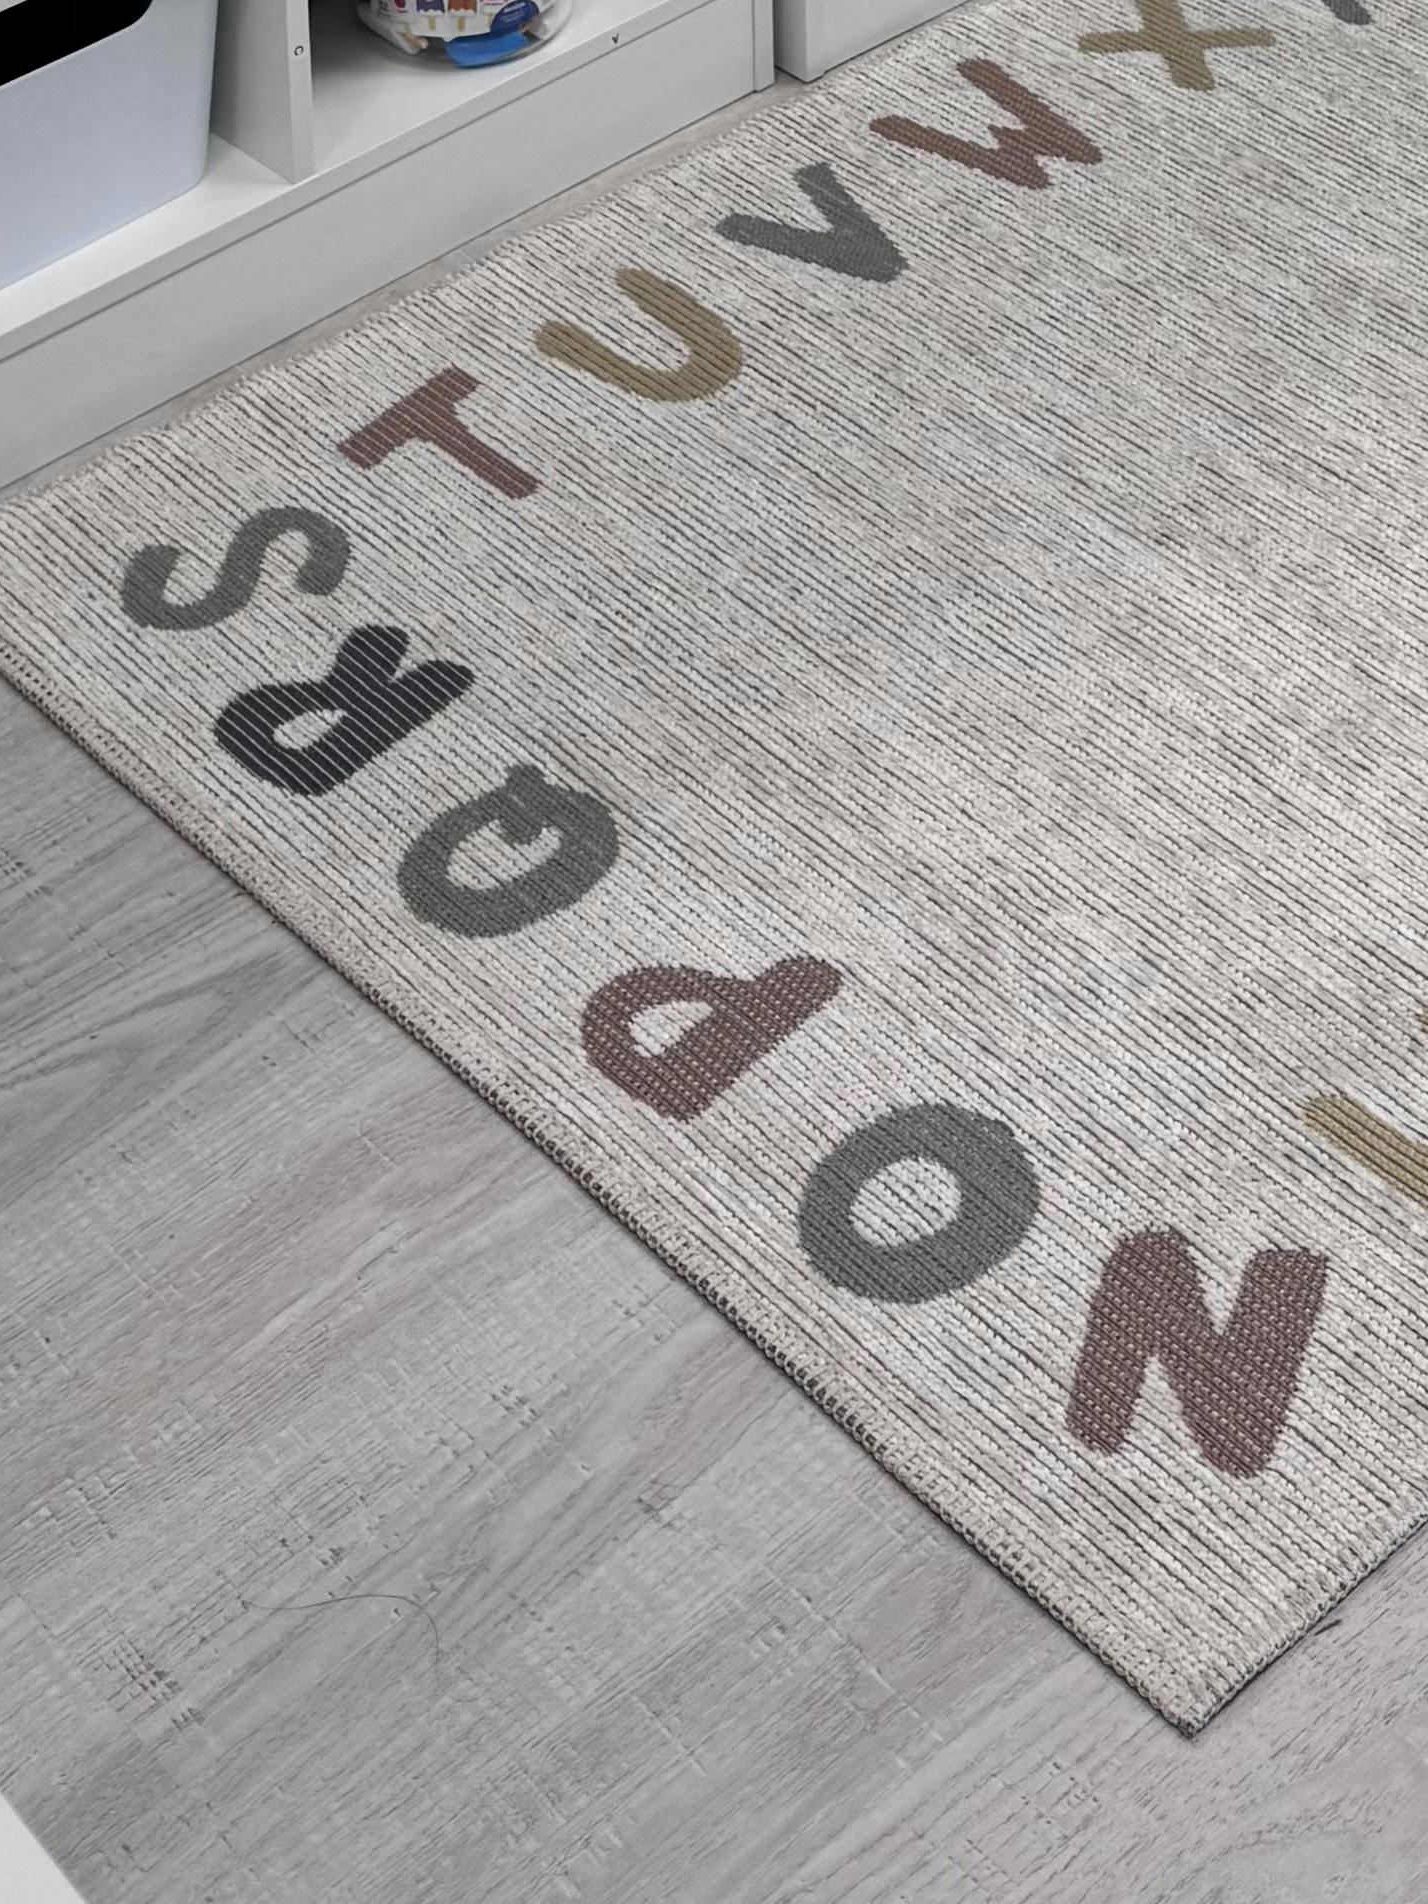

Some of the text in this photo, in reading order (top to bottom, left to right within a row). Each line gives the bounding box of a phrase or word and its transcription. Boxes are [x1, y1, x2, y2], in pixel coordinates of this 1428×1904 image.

[334, 367, 538, 500] T
[534, 268, 745, 403] U
[716, 162, 910, 284] V
[869, 58, 1102, 190] W
[117, 504, 1328, 1479] N O P Q R S
